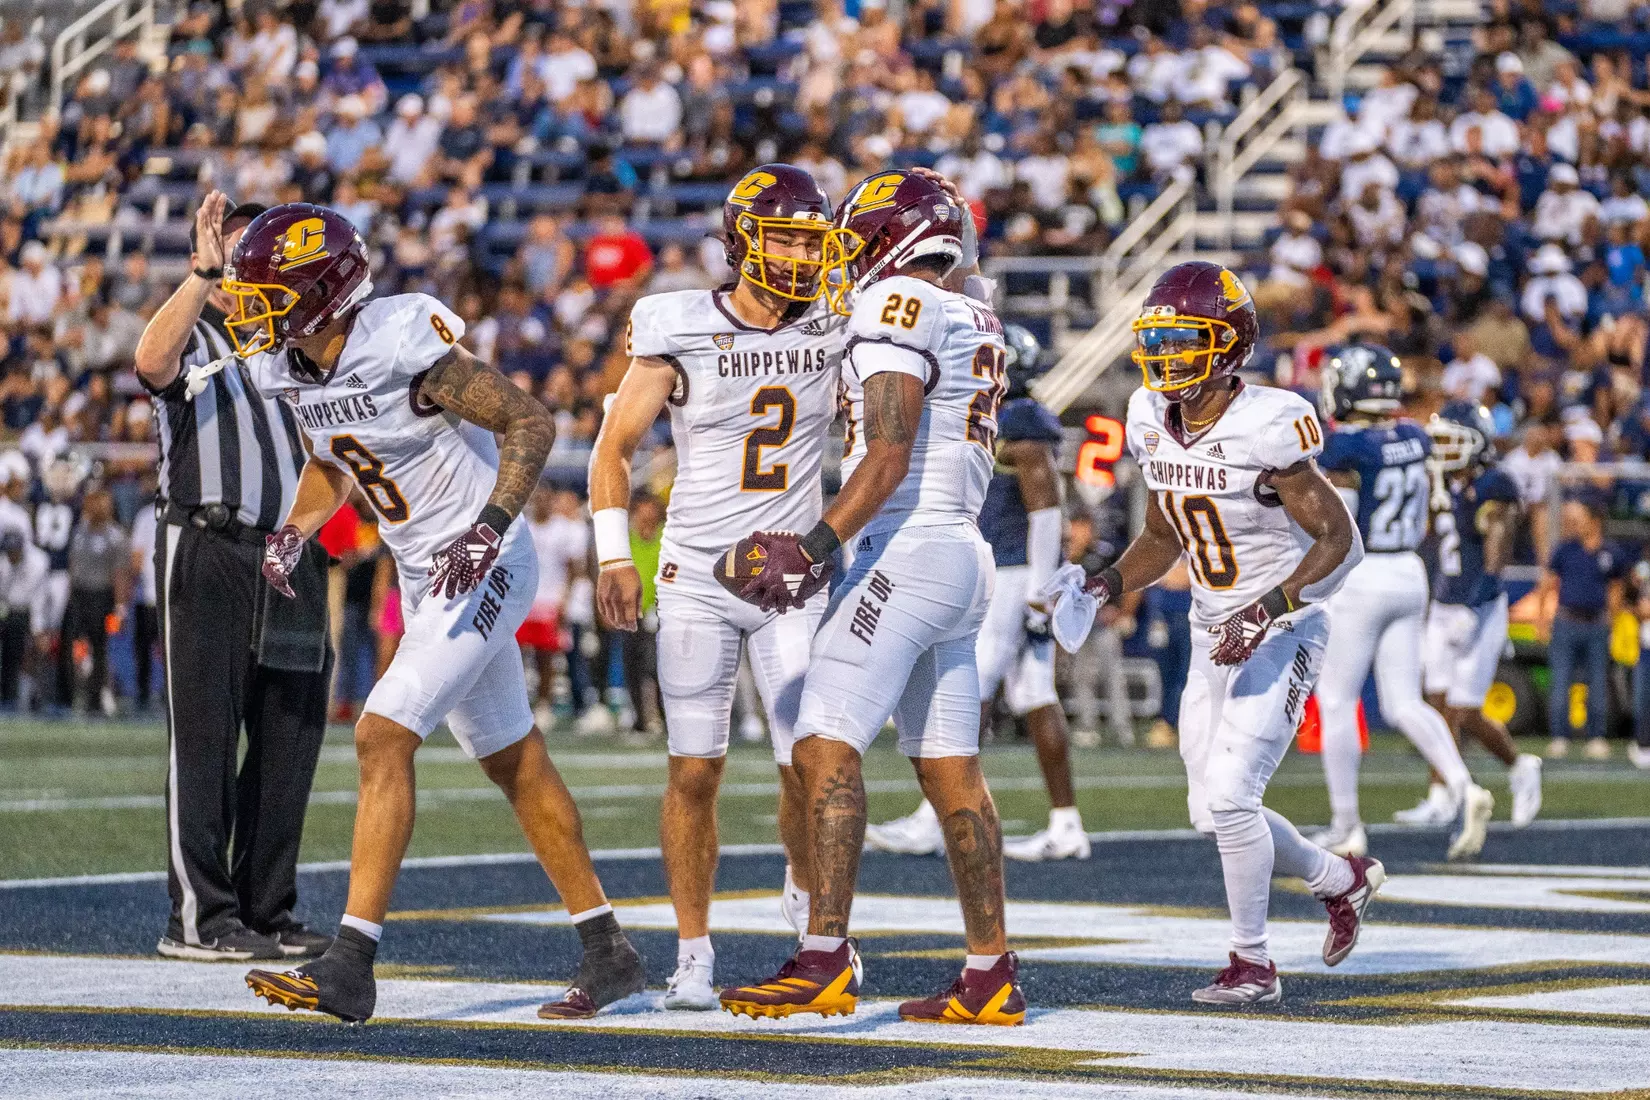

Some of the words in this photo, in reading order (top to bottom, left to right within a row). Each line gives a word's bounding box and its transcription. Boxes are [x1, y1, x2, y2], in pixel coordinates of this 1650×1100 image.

[855, 174, 906, 208] C
[278, 217, 326, 261] C
[430, 313, 456, 345] 8
[880, 293, 922, 331] 29
[801, 329, 825, 337] adidas
[718, 349, 826, 378] CHIPPEWAS
[345, 382, 368, 390] adidas
[965, 343, 1007, 450] 2
[740, 385, 798, 492] 2
[1076, 414, 1125, 489] 2
[1294, 415, 1320, 452] 10
[1150, 460, 1227, 491] CHIPPEWAS
[1206, 451, 1226, 460] adidas
[330, 433, 411, 524] 8
[1367, 463, 1430, 552] 22
[1165, 490, 1240, 591] 10
[473, 590, 502, 642] FIRE
[488, 565, 514, 601] UP!
[850, 595, 882, 646] FIRE
[1292, 643, 1312, 682] UP!
[1285, 677, 1301, 724] FIRE
